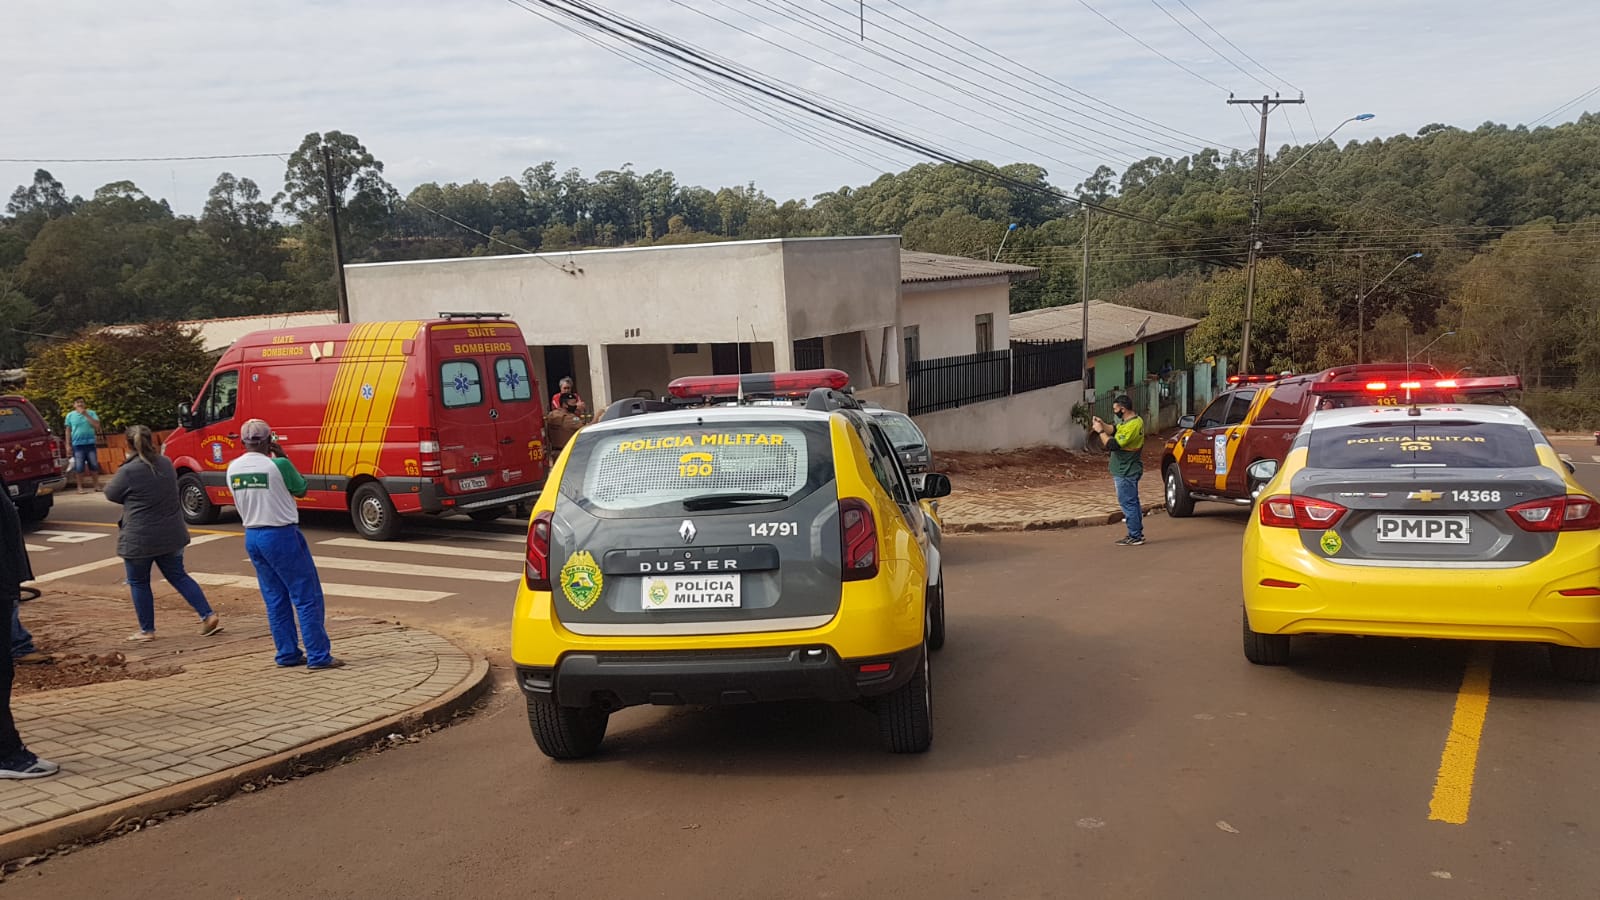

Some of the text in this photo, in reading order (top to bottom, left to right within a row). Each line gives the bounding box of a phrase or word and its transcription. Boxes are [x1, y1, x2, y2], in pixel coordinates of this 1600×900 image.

[262, 346, 304, 357] BOMBEIROS
[454, 342, 512, 354] BOMBEIROS
[619, 433, 785, 453] POLÍCIA MILITAR
[1347, 436, 1412, 445] POLÍCIA
[528, 450, 543, 461] 193
[405, 466, 419, 475] 193
[679, 464, 713, 477] 190
[1451, 490, 1501, 502] 14368
[748, 522, 798, 537] 14791
[1382, 519, 1464, 539] PMPR
[640, 559, 738, 572] DUSTER
[675, 578, 734, 591] POLÍCIA
[674, 593, 734, 604] MILITAR
